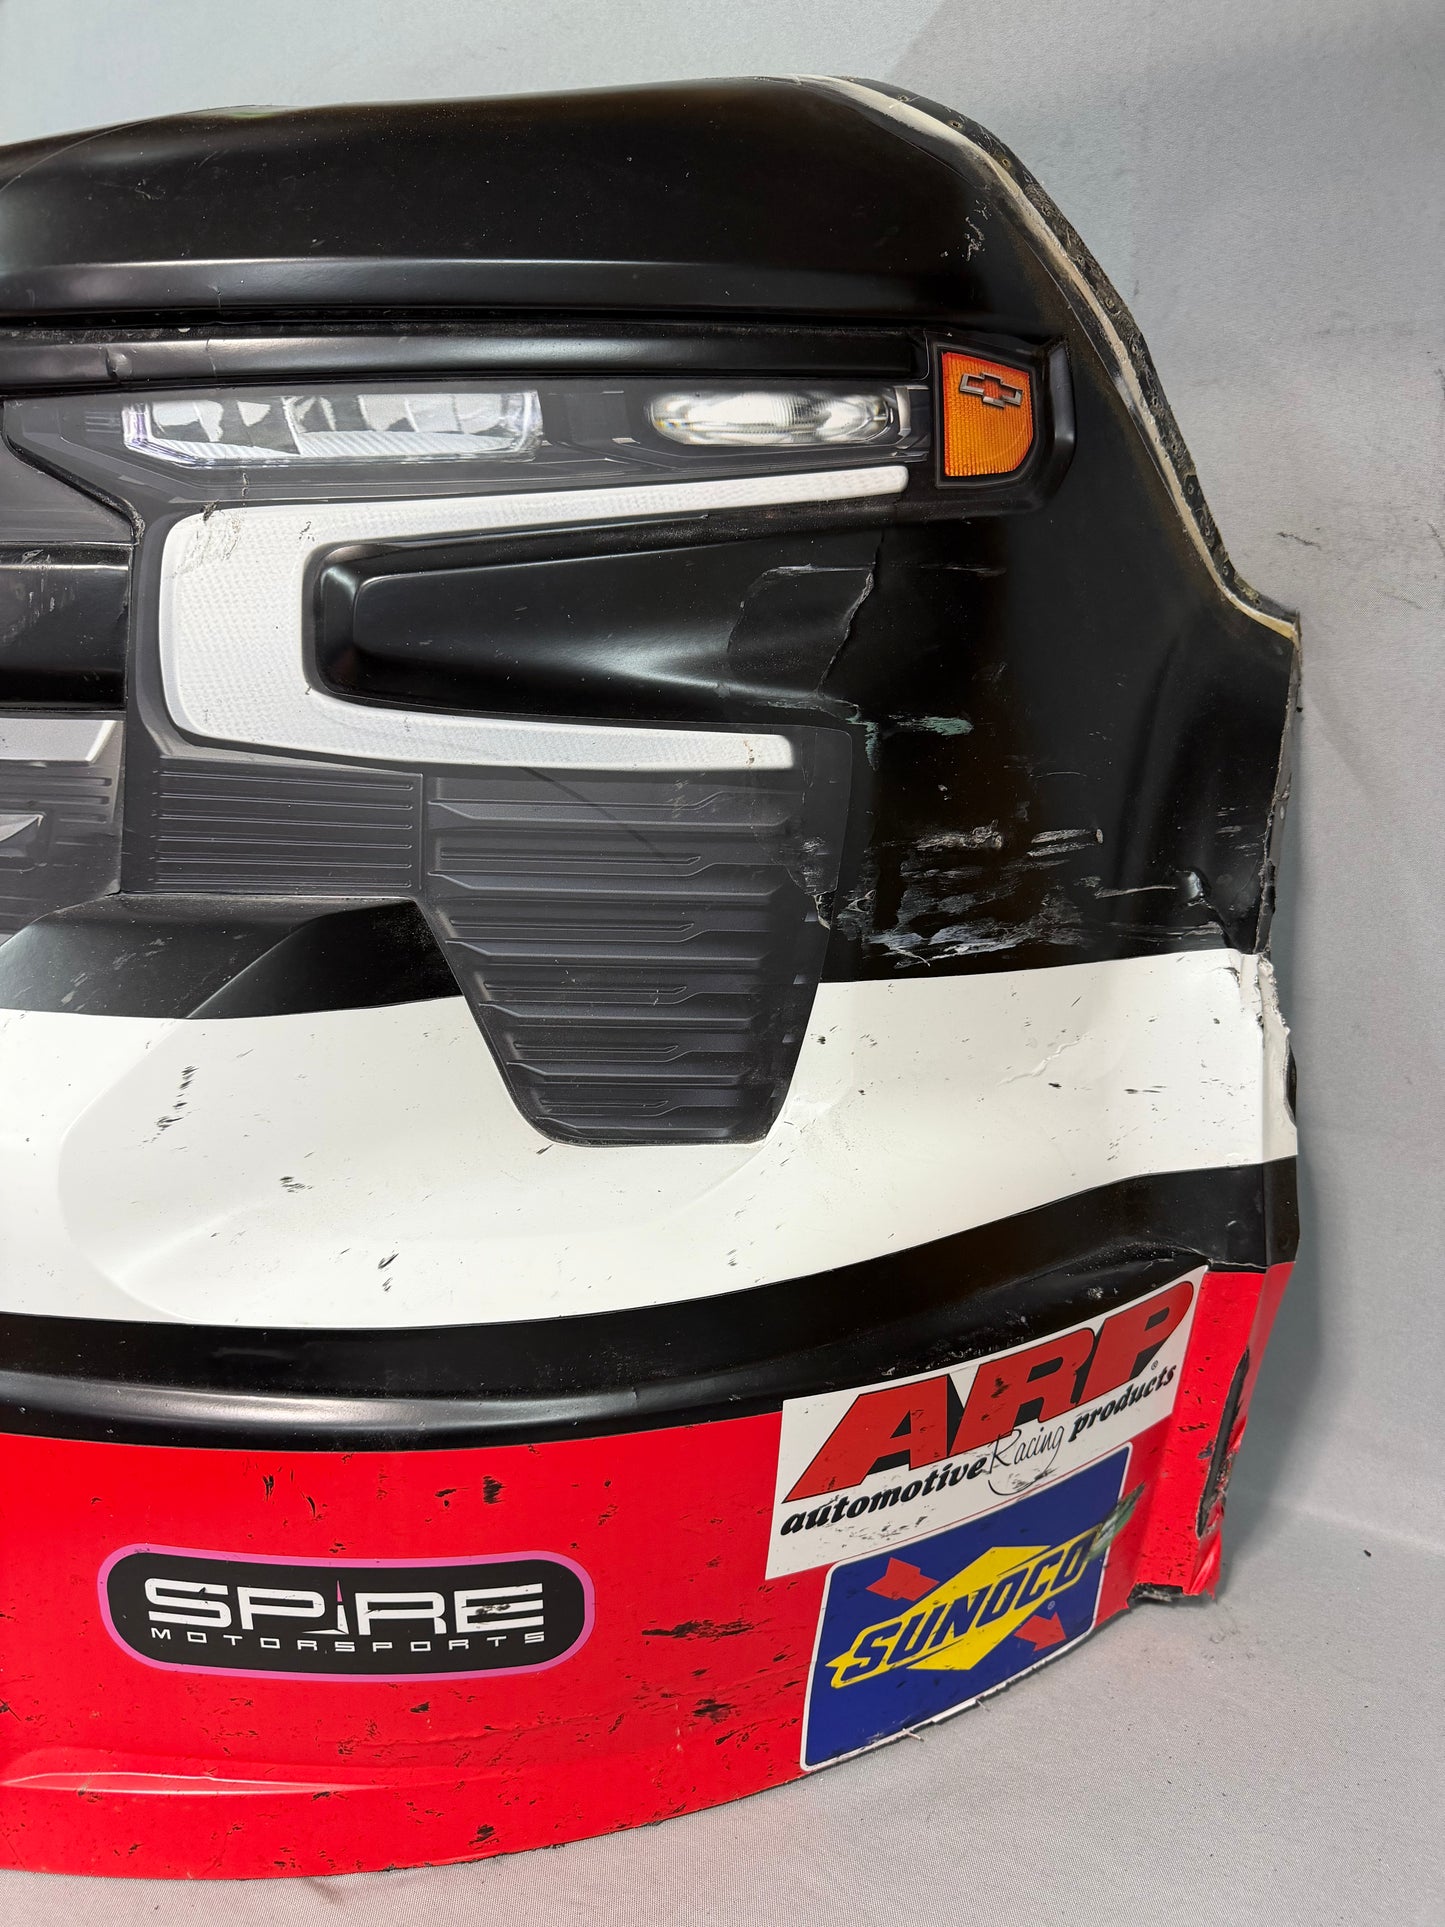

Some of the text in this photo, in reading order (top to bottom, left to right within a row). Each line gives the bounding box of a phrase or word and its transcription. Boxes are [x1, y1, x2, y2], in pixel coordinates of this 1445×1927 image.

[780, 1363, 1177, 1536] automotive Racing products
[782, 1281, 1194, 1504] ARP
[144, 1577, 544, 1636] SPIRE
[151, 1627, 545, 1652] MOTORSPORTS
[836, 1529, 1103, 1685] SUNOCO
